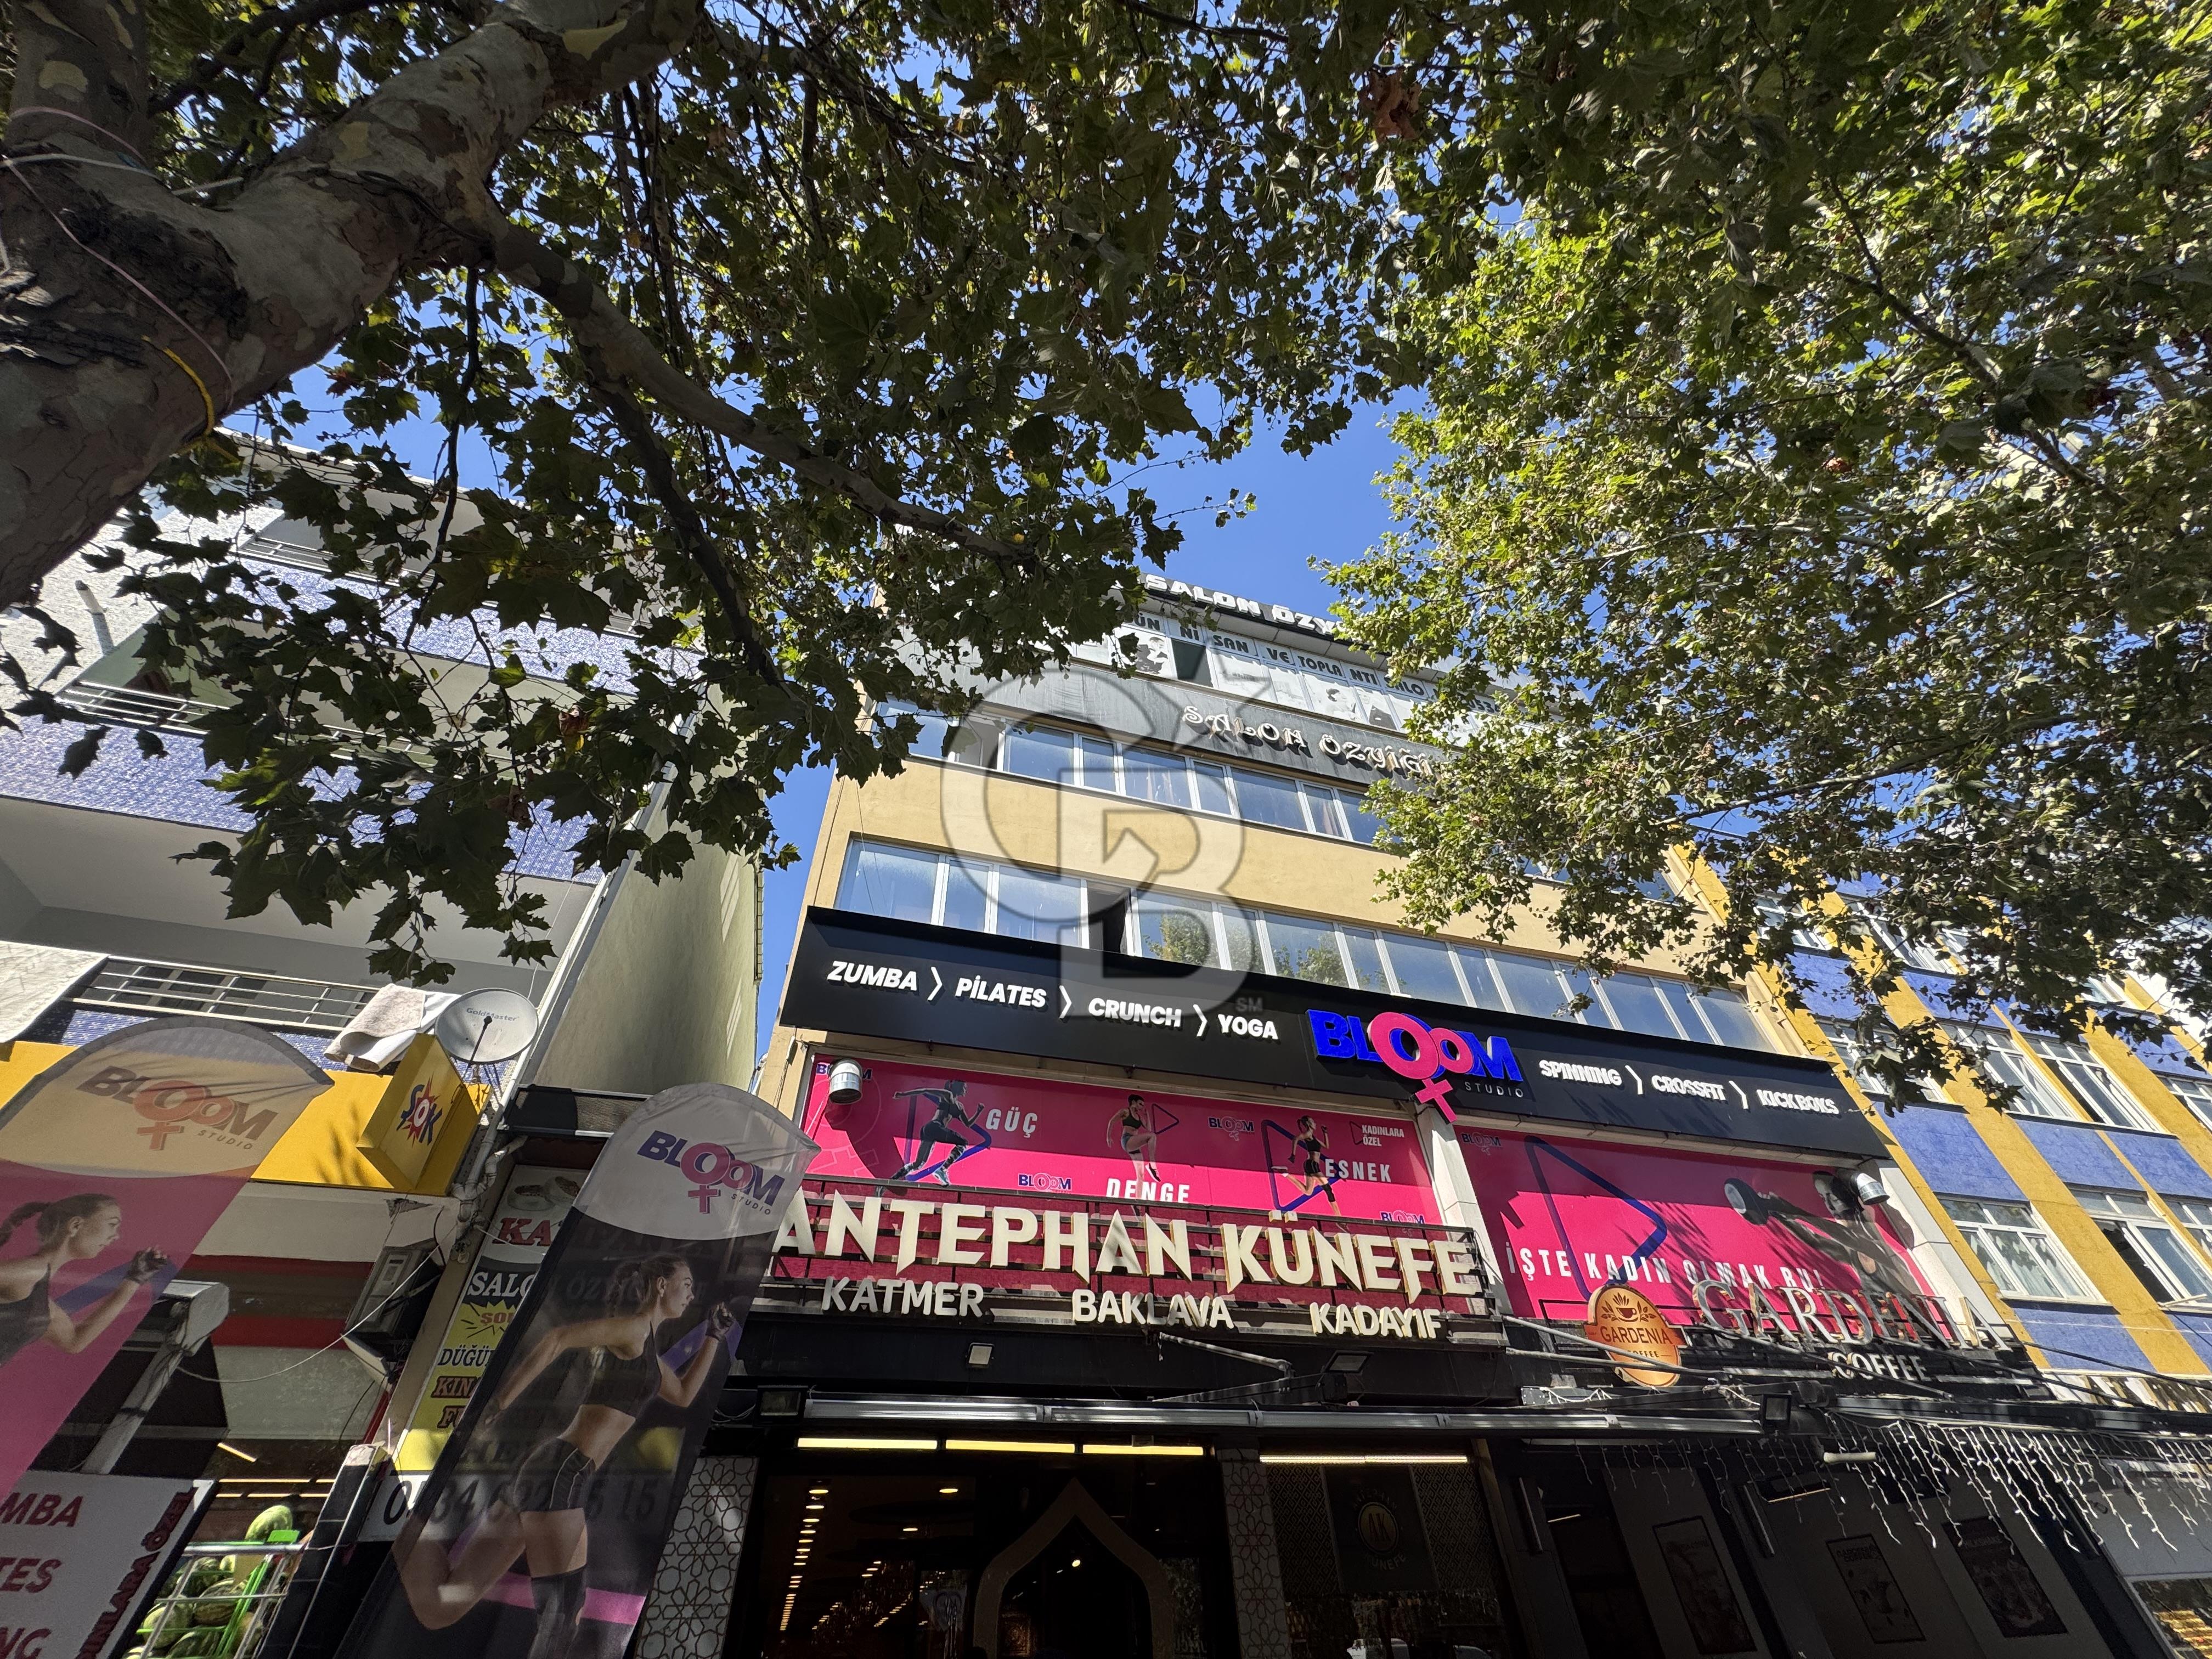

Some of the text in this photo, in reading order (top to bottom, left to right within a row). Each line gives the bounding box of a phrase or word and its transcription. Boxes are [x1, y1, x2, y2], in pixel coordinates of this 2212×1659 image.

[1144, 574, 1347, 635] SALON ÖZY
[1266, 647, 1290, 664] VE
[1182, 706, 1433, 777] SALON ÖZYİĞİ
[827, 961, 918, 992] ZUMBA
[955, 974, 1047, 1008] PİLATES
[466, 1008, 518, 1022] GoldMaster
[1088, 997, 1182, 1028] CRUNCH
[1218, 1013, 1278, 1040] YOGA
[1306, 1008, 1524, 1082] BLOOM
[1538, 1059, 1622, 1086] SPINNING
[1464, 1081, 1524, 1098] STUDIO
[1651, 1074, 1726, 1101] CROSSFIT
[76, 1065, 278, 1141] BLOOM
[986, 1107, 1038, 1137] GÜÇ
[1208, 1117, 1255, 1132] BLOOM
[1362, 1125, 1405, 1138] KADINLARA
[198, 1129, 253, 1150] STUDIO
[1363, 1134, 1382, 1147] ÖZEL
[636, 1130, 786, 1206] BLOOM
[1325, 1158, 1392, 1183] ESNEK
[1018, 1173, 1071, 1191] BLOOM
[1106, 1177, 1190, 1204] DENGE
[731, 1193, 771, 1215] STUDIO
[772, 1186, 1485, 1304] ANTEPHAN KÜNEFE
[1506, 1242, 1572, 1280] İŞTE
[1584, 1252, 1672, 1284] KADIN
[822, 1276, 984, 1317] KATMER
[1073, 1289, 1234, 1329] BAKLAVA
[1309, 1302, 1441, 1339] KADAYIF
[1692, 1279, 2014, 1352] GARDENIA
[1600, 1325, 1673, 1345] GARDENIA
[437, 1345, 495, 1367] DÜĞÜ
[1627, 1350, 1660, 1358] OFFEE
[1827, 1351, 1933, 1381] COFFEE
[431, 1376, 482, 1398] KIN
